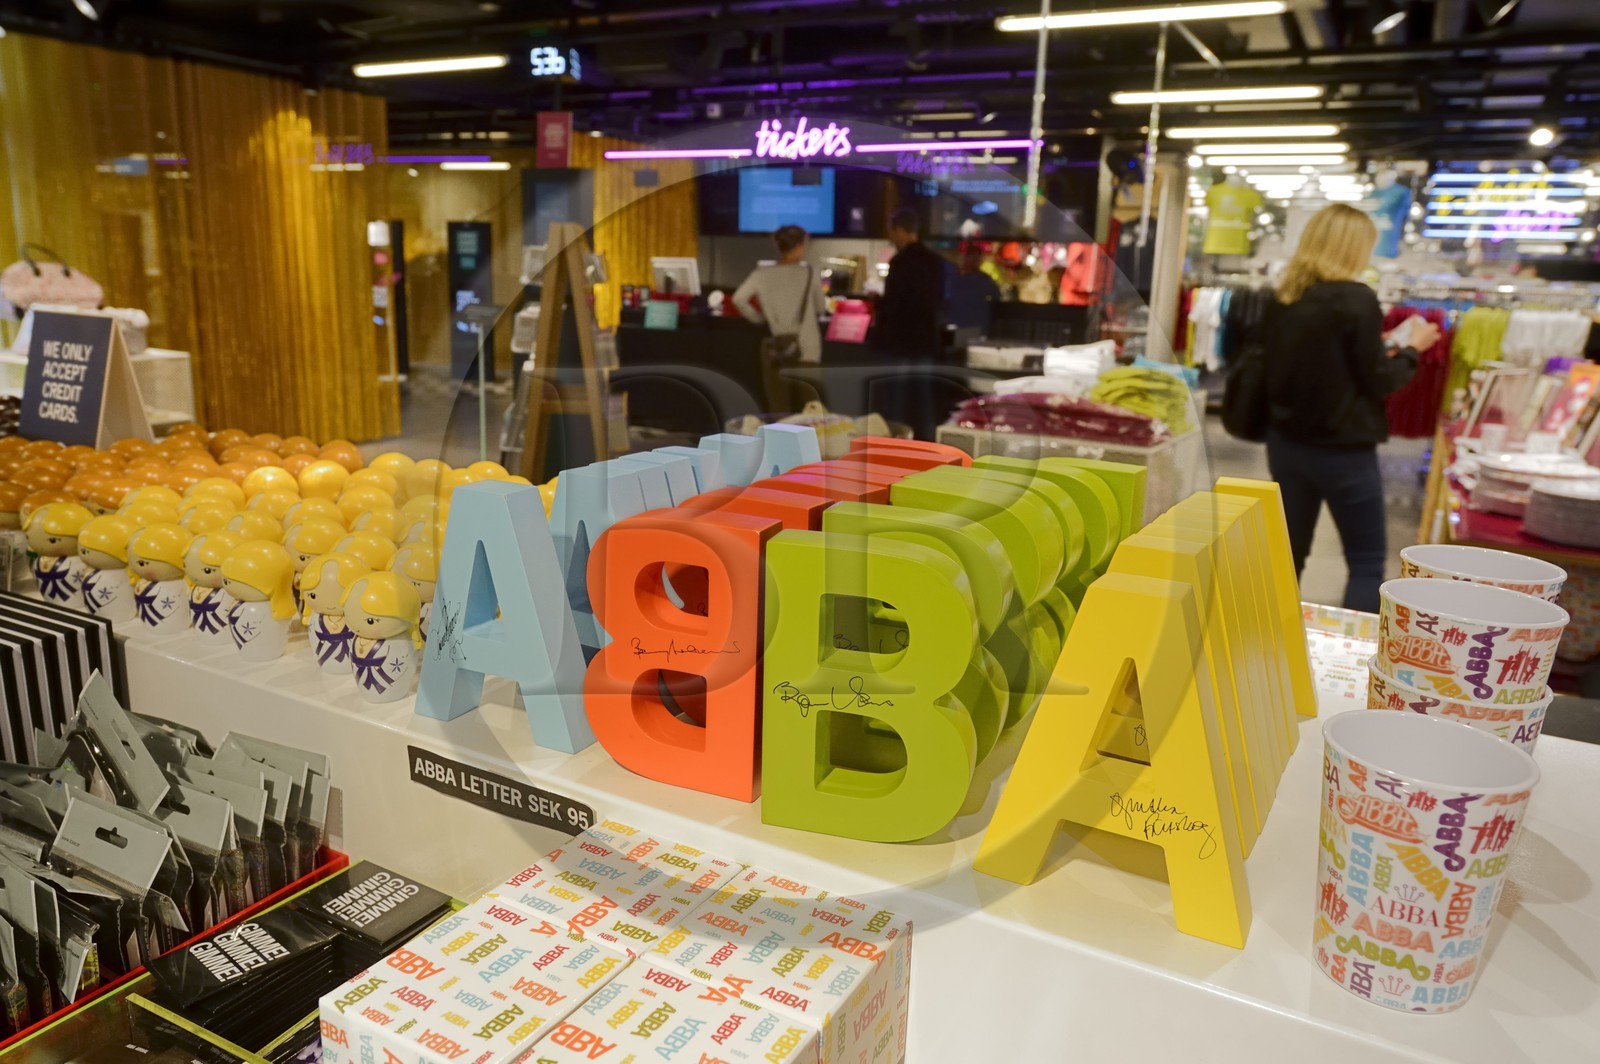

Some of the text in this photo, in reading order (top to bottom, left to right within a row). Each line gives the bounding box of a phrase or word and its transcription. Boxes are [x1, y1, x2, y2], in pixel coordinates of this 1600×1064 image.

[755, 116, 851, 160] tickets
[43, 340, 93, 362] WE ONLY
[42, 361, 87, 382] ACCEPT
[42, 381, 83, 402] CREDIT
[39, 401, 79, 423] CARDS.
[1464, 626, 1509, 700] ABBA
[414, 757, 589, 831] ABBA LETTER SEK 95
[600, 818, 640, 836] ABBA
[1433, 793, 1485, 872] ABBA
[579, 842, 613, 857] ABBA
[620, 837, 660, 863] ABBA
[655, 852, 699, 872] ABBA
[506, 864, 543, 888] ABBA
[554, 870, 600, 891] ABBA
[578, 858, 627, 880] ABBA
[685, 869, 721, 895] ABBA
[1346, 831, 1374, 907] ABBA
[1386, 842, 1450, 903] ABBA
[322, 872, 391, 914] GIMME!
[336, 878, 405, 921] GIMME!
[547, 885, 585, 903] ABBA
[730, 886, 767, 914] ABBA
[763, 875, 809, 896] ABBA
[351, 884, 419, 928] GIMME!
[486, 905, 528, 926] ABBA
[519, 893, 564, 915] ABBA
[566, 895, 619, 937] ABBA
[626, 892, 661, 917] ABBA
[760, 907, 797, 926] ABBA
[811, 907, 853, 927] ABBA
[835, 896, 867, 911] ABBA
[1370, 895, 1439, 928] ABBA
[1441, 882, 1476, 939] ABBA
[422, 915, 470, 944] ABBA
[611, 920, 659, 943] ABBA
[697, 911, 749, 937] ABBA
[862, 910, 895, 935] ABBA
[1352, 912, 1434, 954] ABBA
[213, 933, 267, 971] GIMME!
[239, 923, 291, 961] GIMME!
[440, 931, 480, 957] ABBA
[460, 934, 508, 965] ABBA
[651, 924, 693, 956] ABBA
[674, 942, 708, 967] ABBA
[706, 941, 739, 968] ABBA
[742, 930, 786, 965] ABBA
[818, 931, 887, 975] ABBA
[189, 942, 243, 982] GIMME!
[478, 947, 533, 984] ABBA
[532, 944, 570, 971] ABBA
[563, 945, 600, 971] ABBA
[771, 945, 811, 978] ABBA
[803, 953, 835, 981] ABBA
[1336, 935, 1431, 981] ABBA
[576, 956, 622, 989] ABBA
[644, 968, 692, 992] ABBA
[823, 964, 861, 997] ABBA
[333, 977, 388, 1014] ABBA
[390, 986, 436, 1011] ABBA
[454, 990, 494, 1011] ABBA
[512, 976, 567, 1006] ABBA
[582, 982, 628, 1016] ABBA
[760, 986, 811, 1012] ABBA
[1411, 981, 1469, 1004] ABBA
[361, 1006, 395, 1026] ABBA
[472, 1003, 525, 1041] ABBA
[606, 999, 645, 1030] ABBA
[631, 1001, 677, 1039] ABBA
[711, 1013, 746, 1045] ABBA
[745, 1013, 780, 1044] ABBA
[416, 1028, 470, 1060] ABBA
[507, 1016, 546, 1045] ABBA
[655, 1016, 707, 1061] ABBA
[764, 1025, 808, 1064] ABBA
